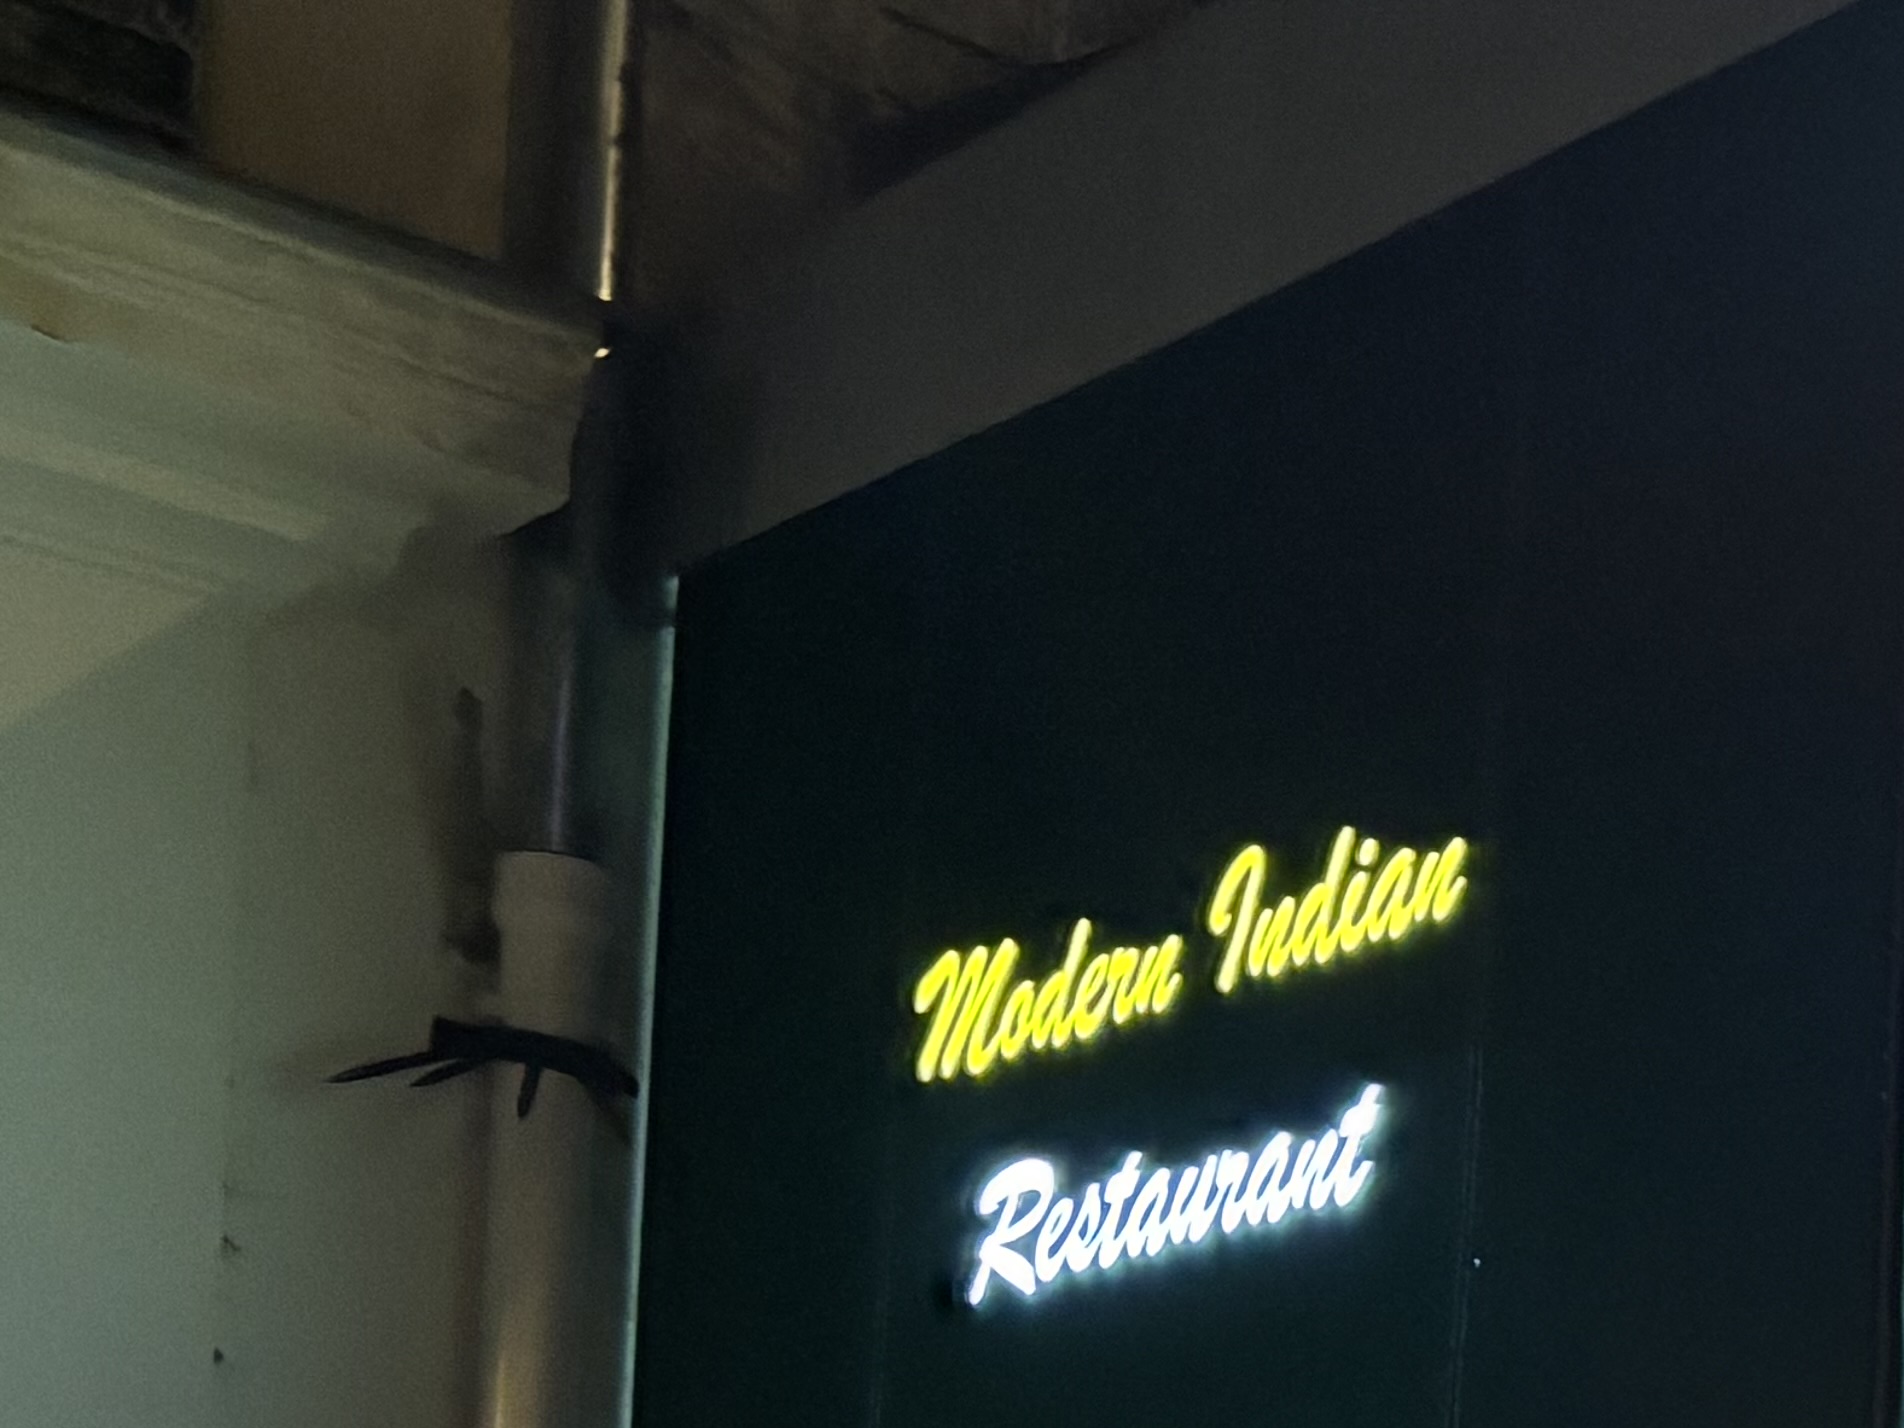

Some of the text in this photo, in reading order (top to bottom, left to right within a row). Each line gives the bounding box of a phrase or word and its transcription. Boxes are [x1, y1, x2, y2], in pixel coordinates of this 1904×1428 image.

[914, 825, 1468, 1083] Modern Indian
[967, 1083, 1384, 1306] Restaurant
